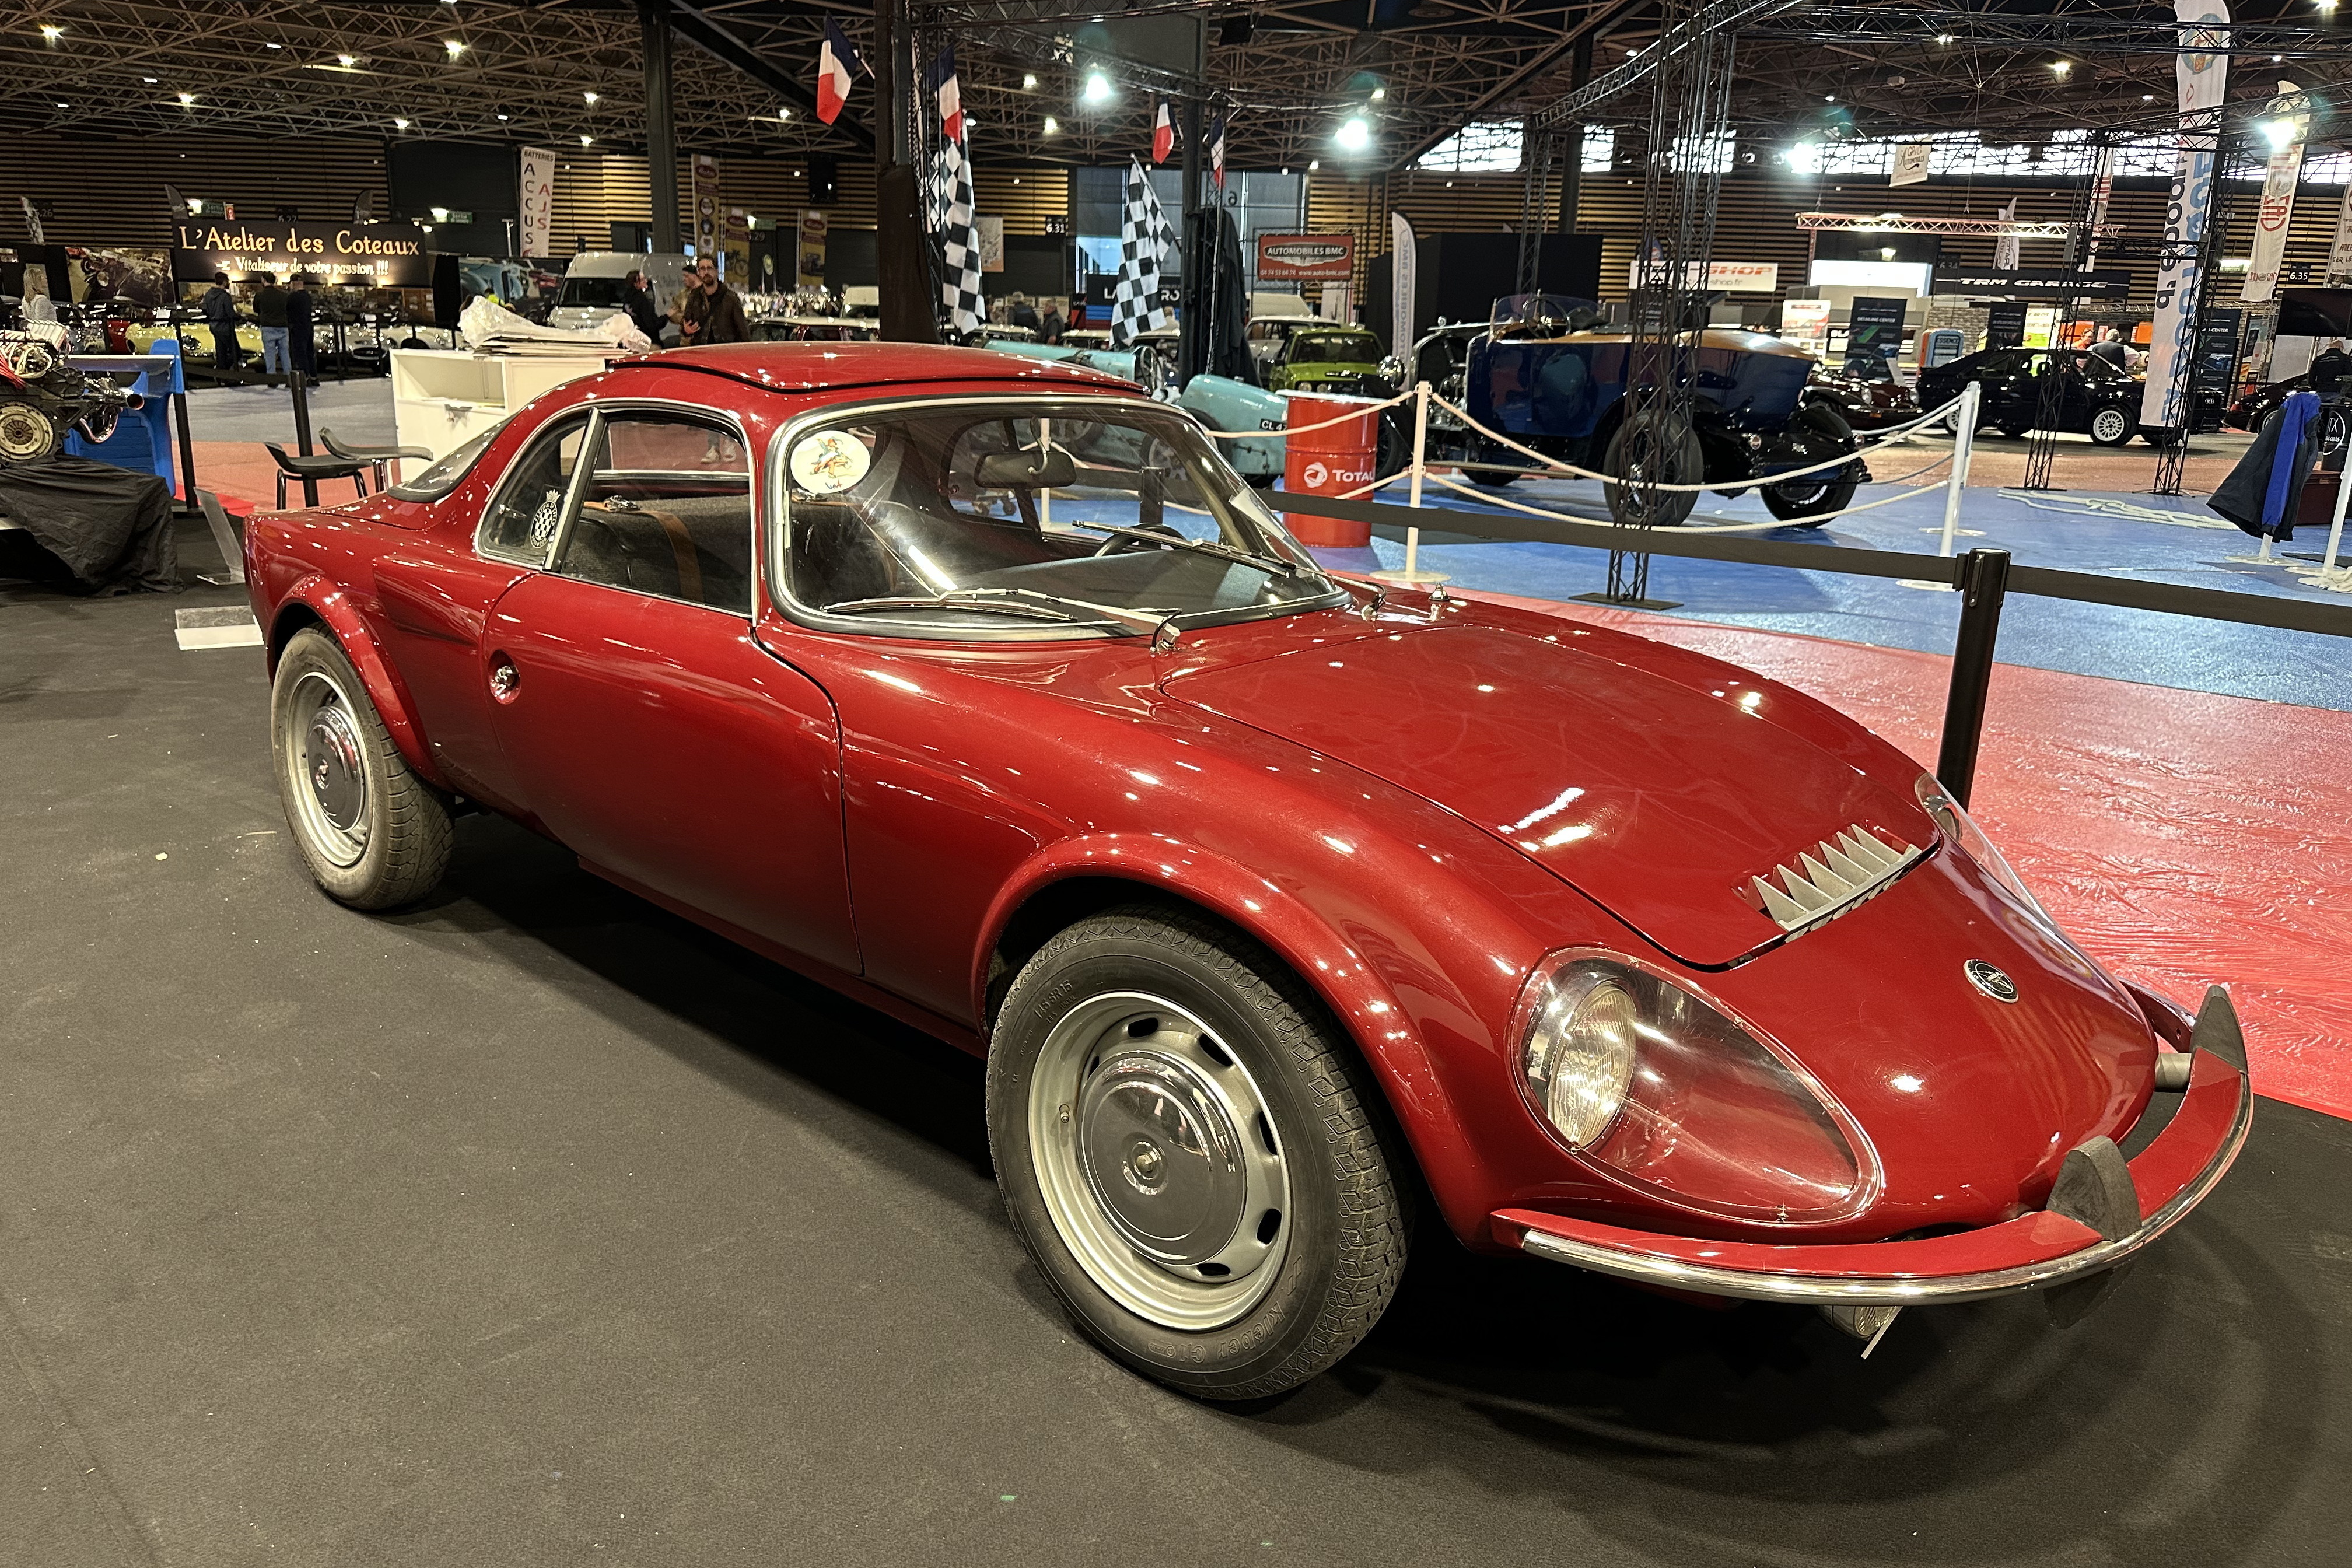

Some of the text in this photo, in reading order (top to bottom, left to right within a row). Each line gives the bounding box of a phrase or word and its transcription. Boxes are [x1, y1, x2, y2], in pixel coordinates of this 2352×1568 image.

[524, 150, 554, 162] BATTERIES
[524, 163, 536, 244] ACCUS
[537, 183, 551, 230] AJS
[1046, 223, 1065, 233] 6.31
[286, 228, 324, 254] des
[335, 230, 420, 256] Coteaux
[1267, 247, 1344, 256] AUTOMOBILES BMC
[235, 256, 388, 278] Vitaliseur de votre passion !!!
[2290, 272, 2308, 280] 6.35
[1959, 278, 2109, 288] TRM GARAGE
[1261, 419, 1275, 430] CL
[1332, 469, 1375, 482] TOTAL
